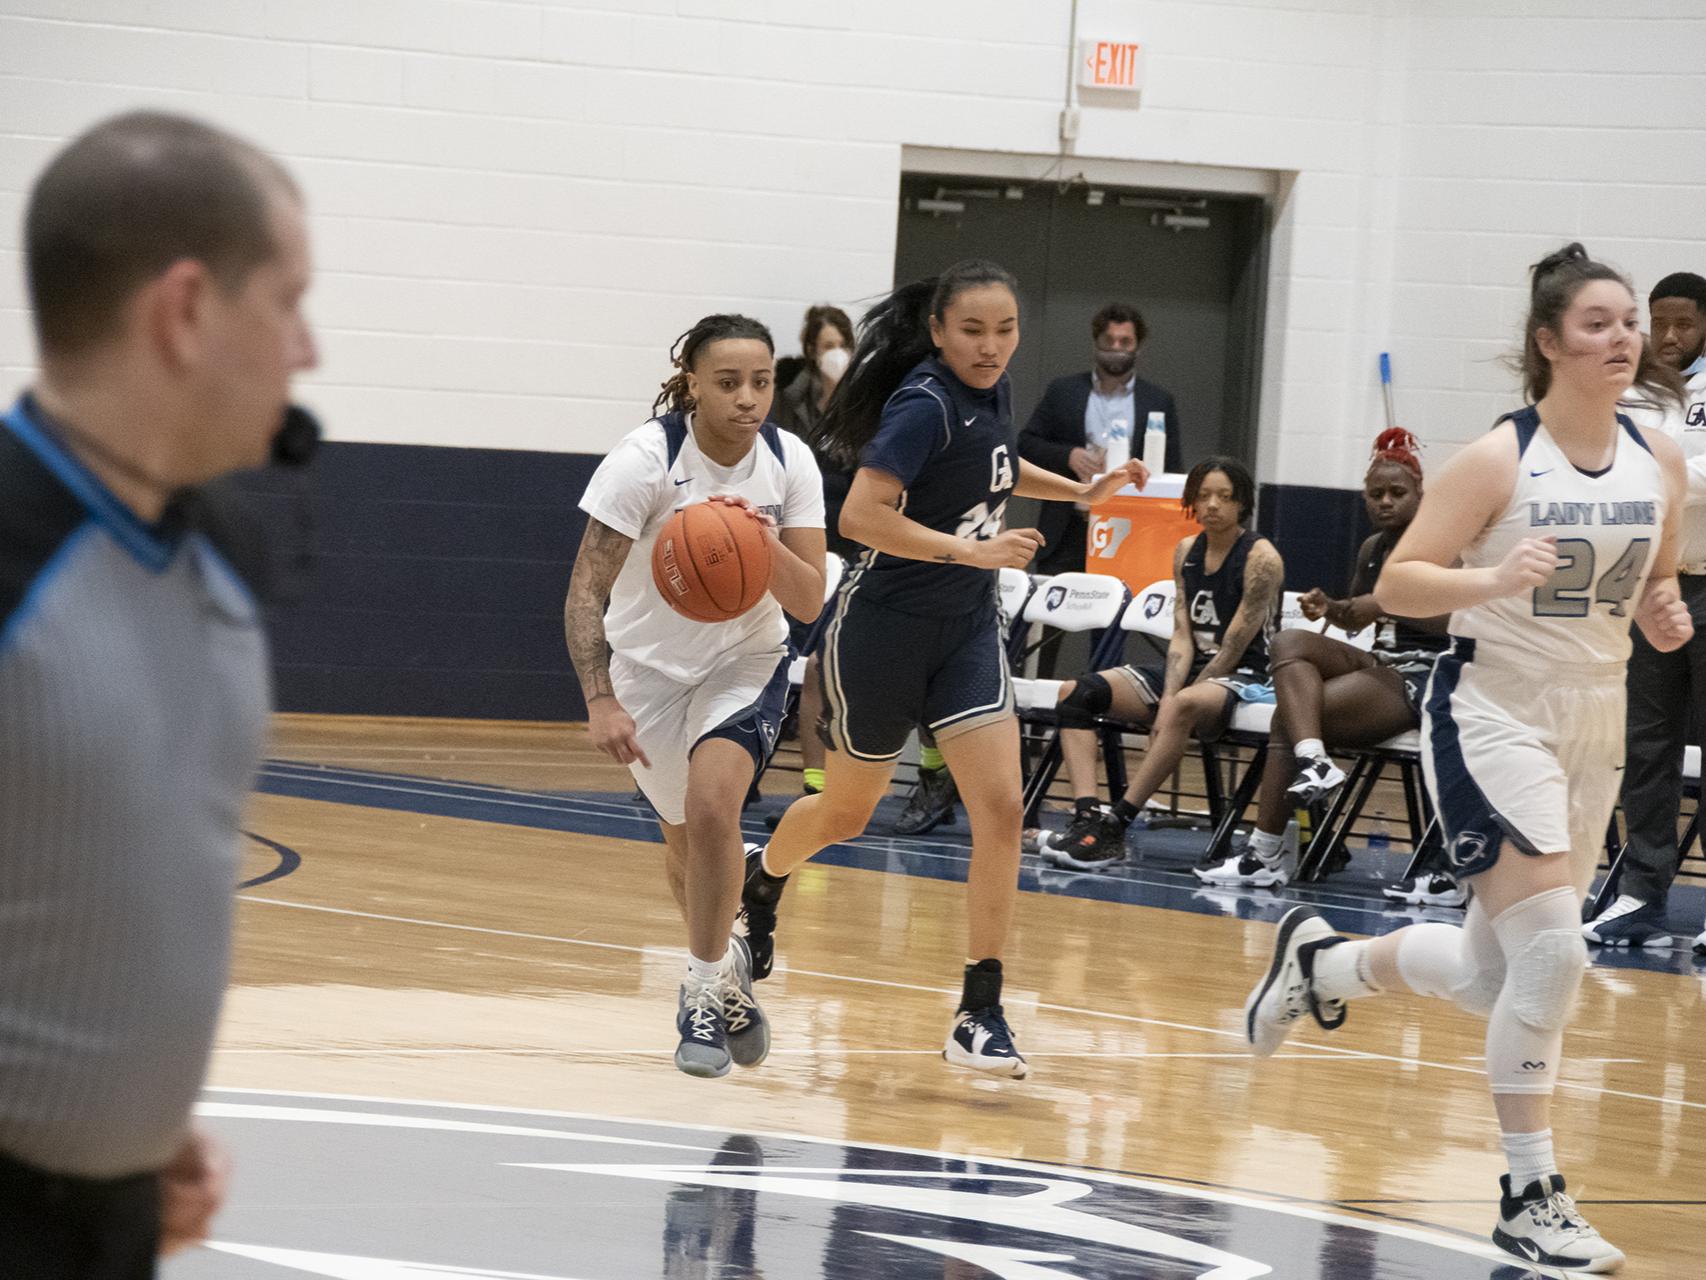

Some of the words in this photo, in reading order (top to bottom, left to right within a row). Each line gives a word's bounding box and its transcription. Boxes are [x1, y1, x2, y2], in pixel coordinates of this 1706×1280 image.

[1095, 42, 1138, 86] EXIT
[1530, 502, 1594, 527] LADY
[1600, 501, 1656, 526] LIONS
[1532, 537, 1651, 618] 24
[1191, 590, 1220, 626] GA
